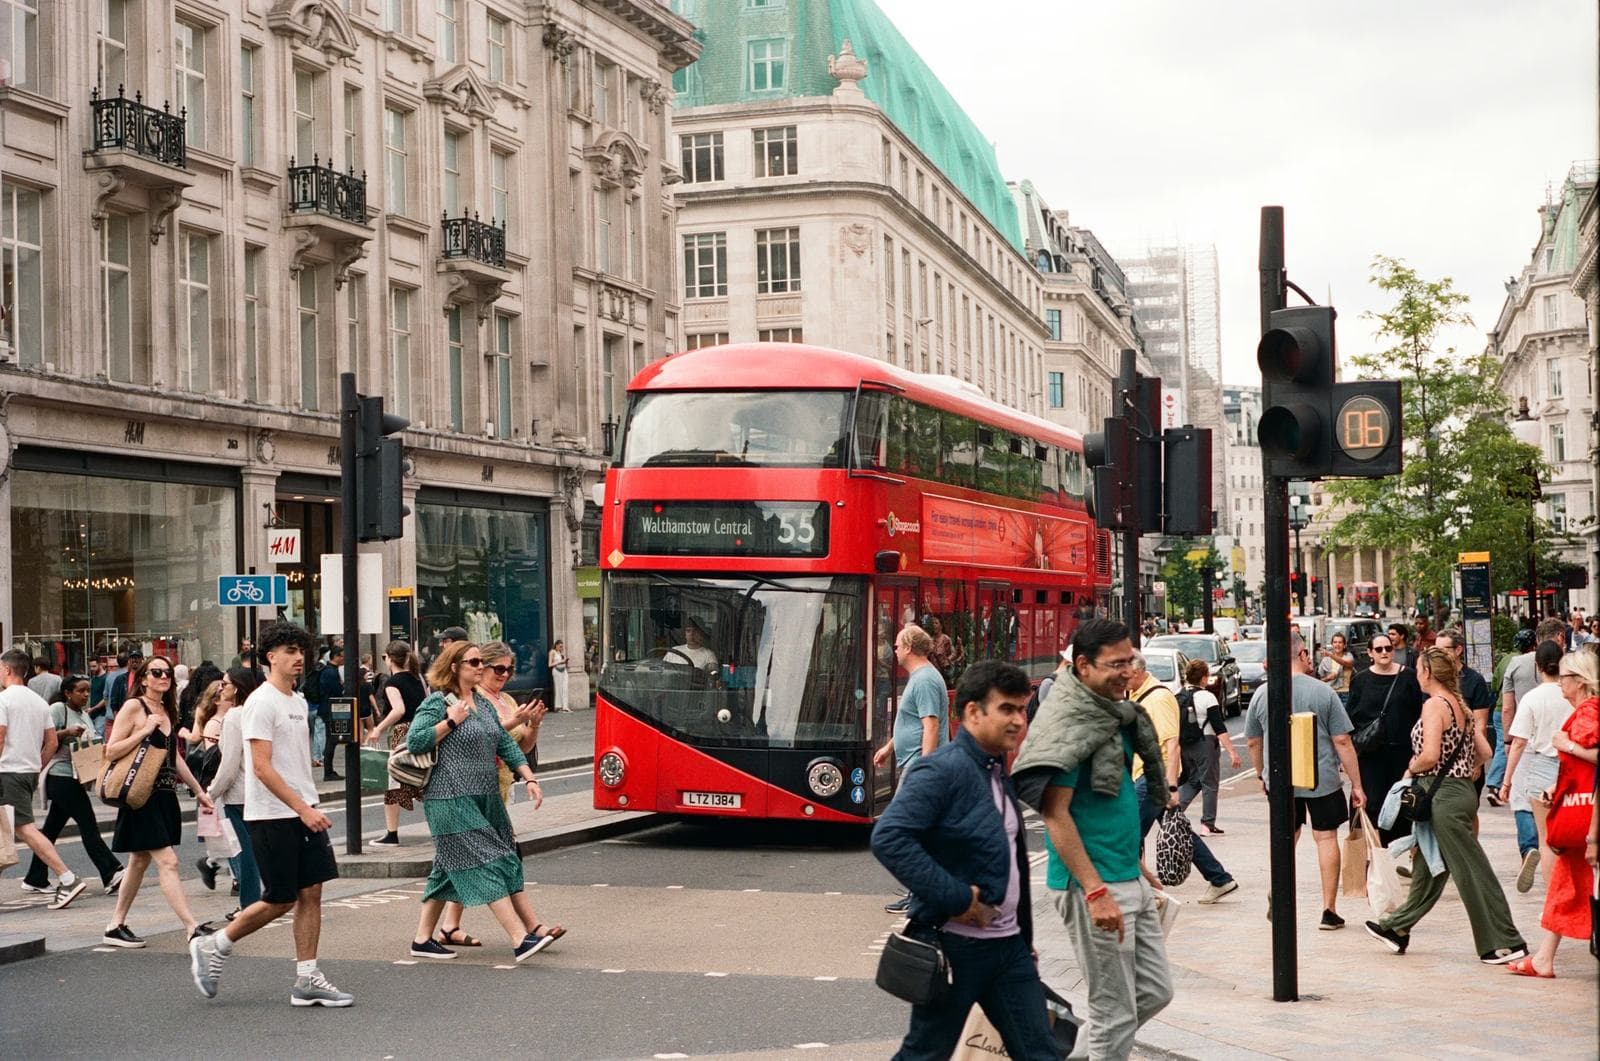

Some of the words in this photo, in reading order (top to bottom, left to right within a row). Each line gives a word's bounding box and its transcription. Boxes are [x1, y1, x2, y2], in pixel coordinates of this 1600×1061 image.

[125, 420, 145, 444] H&M
[1344, 410, 1383, 448] 06
[642, 516, 710, 535] Walthamstow
[714, 518, 752, 535] Central
[777, 512, 815, 544] 55
[270, 536, 295, 555] H&M
[965, 1033, 1009, 1058] Clark
